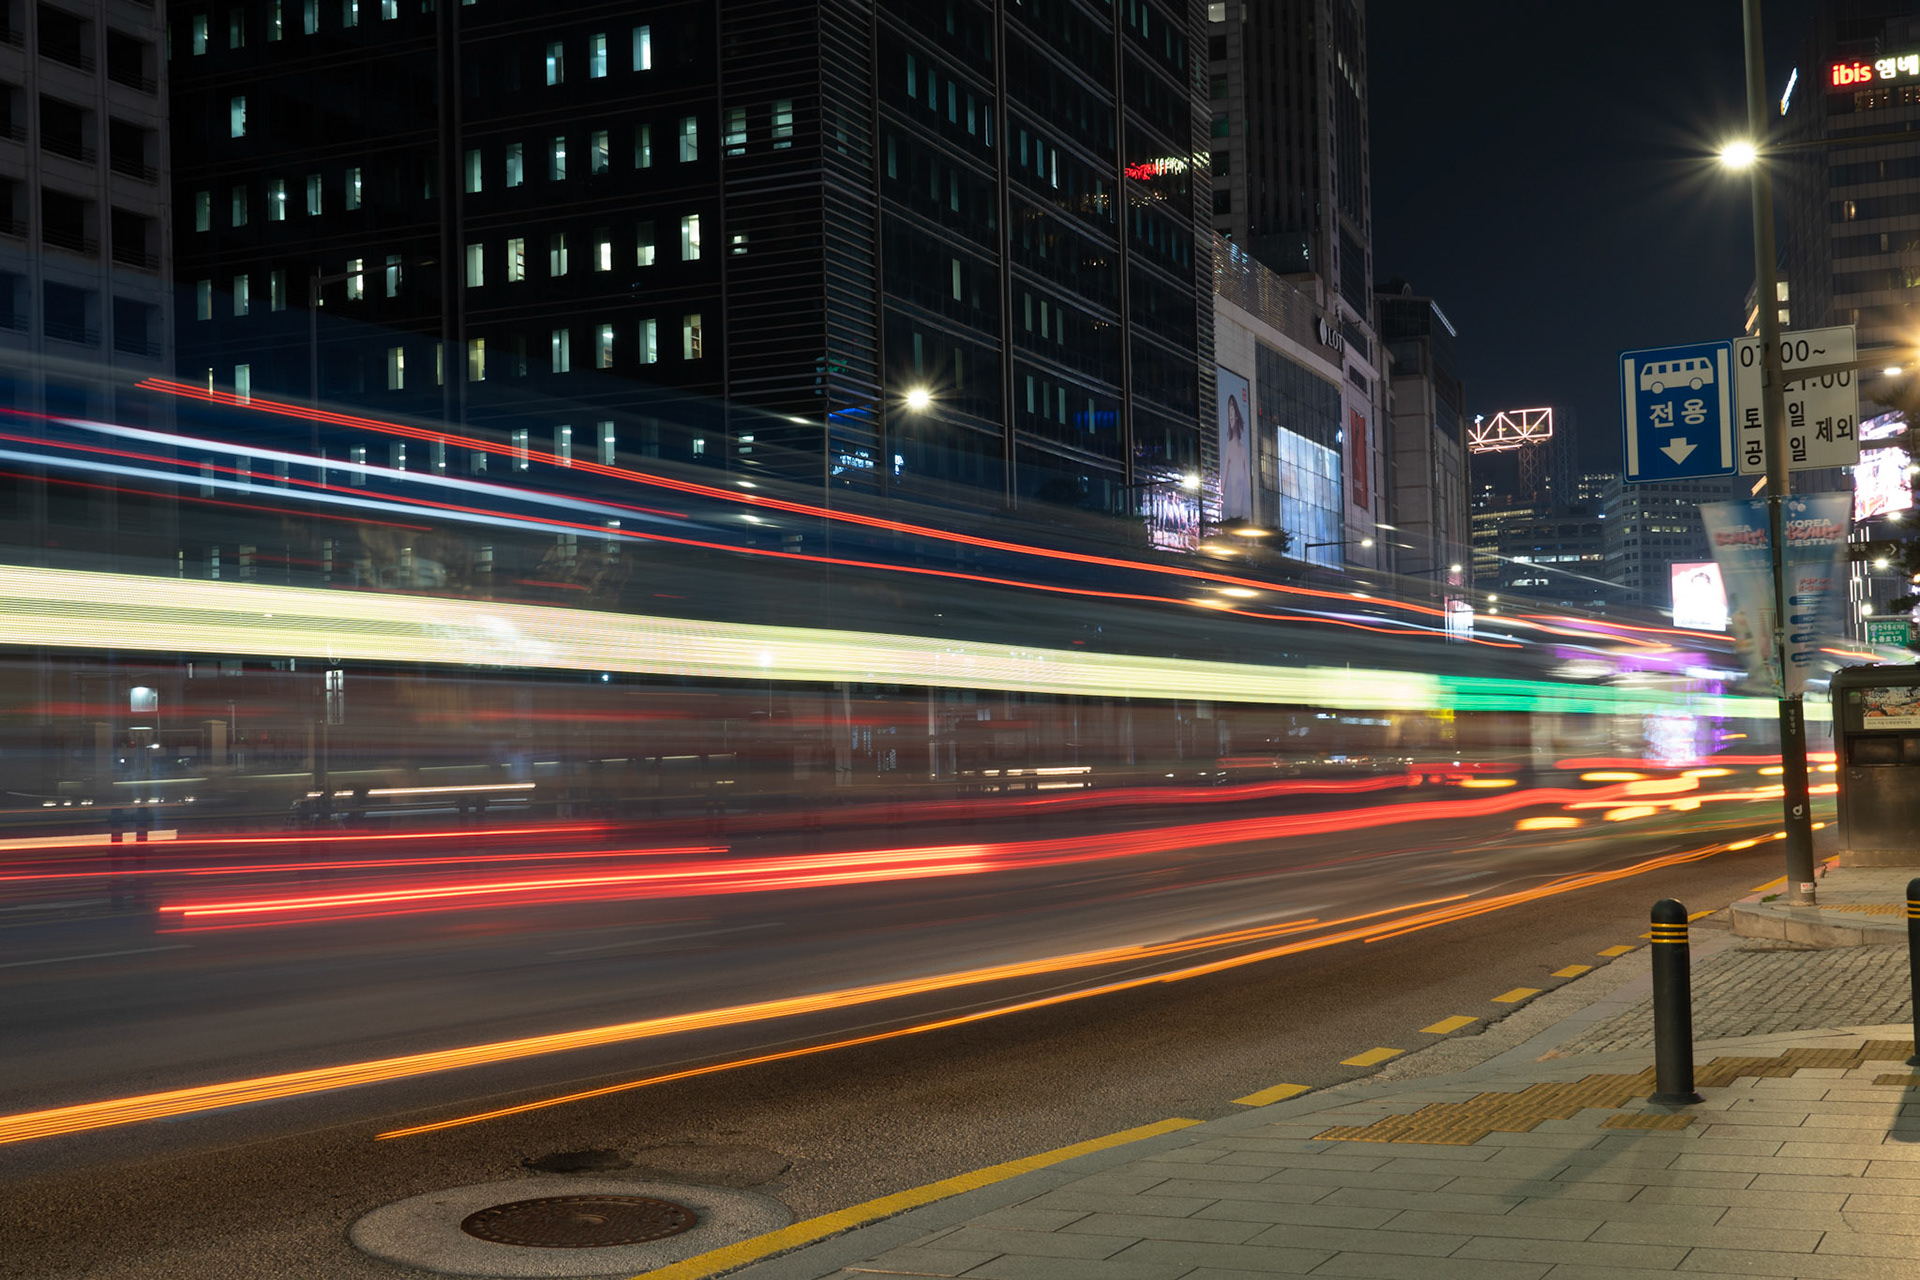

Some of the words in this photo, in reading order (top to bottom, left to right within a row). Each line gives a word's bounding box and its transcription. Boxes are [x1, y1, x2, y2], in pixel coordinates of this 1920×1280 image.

[1832, 62, 1872, 85] ibis
[1649, 398, 1707, 428] 전용
[1815, 415, 1853, 442] 제외
[1786, 518, 1831, 528] KOREA
